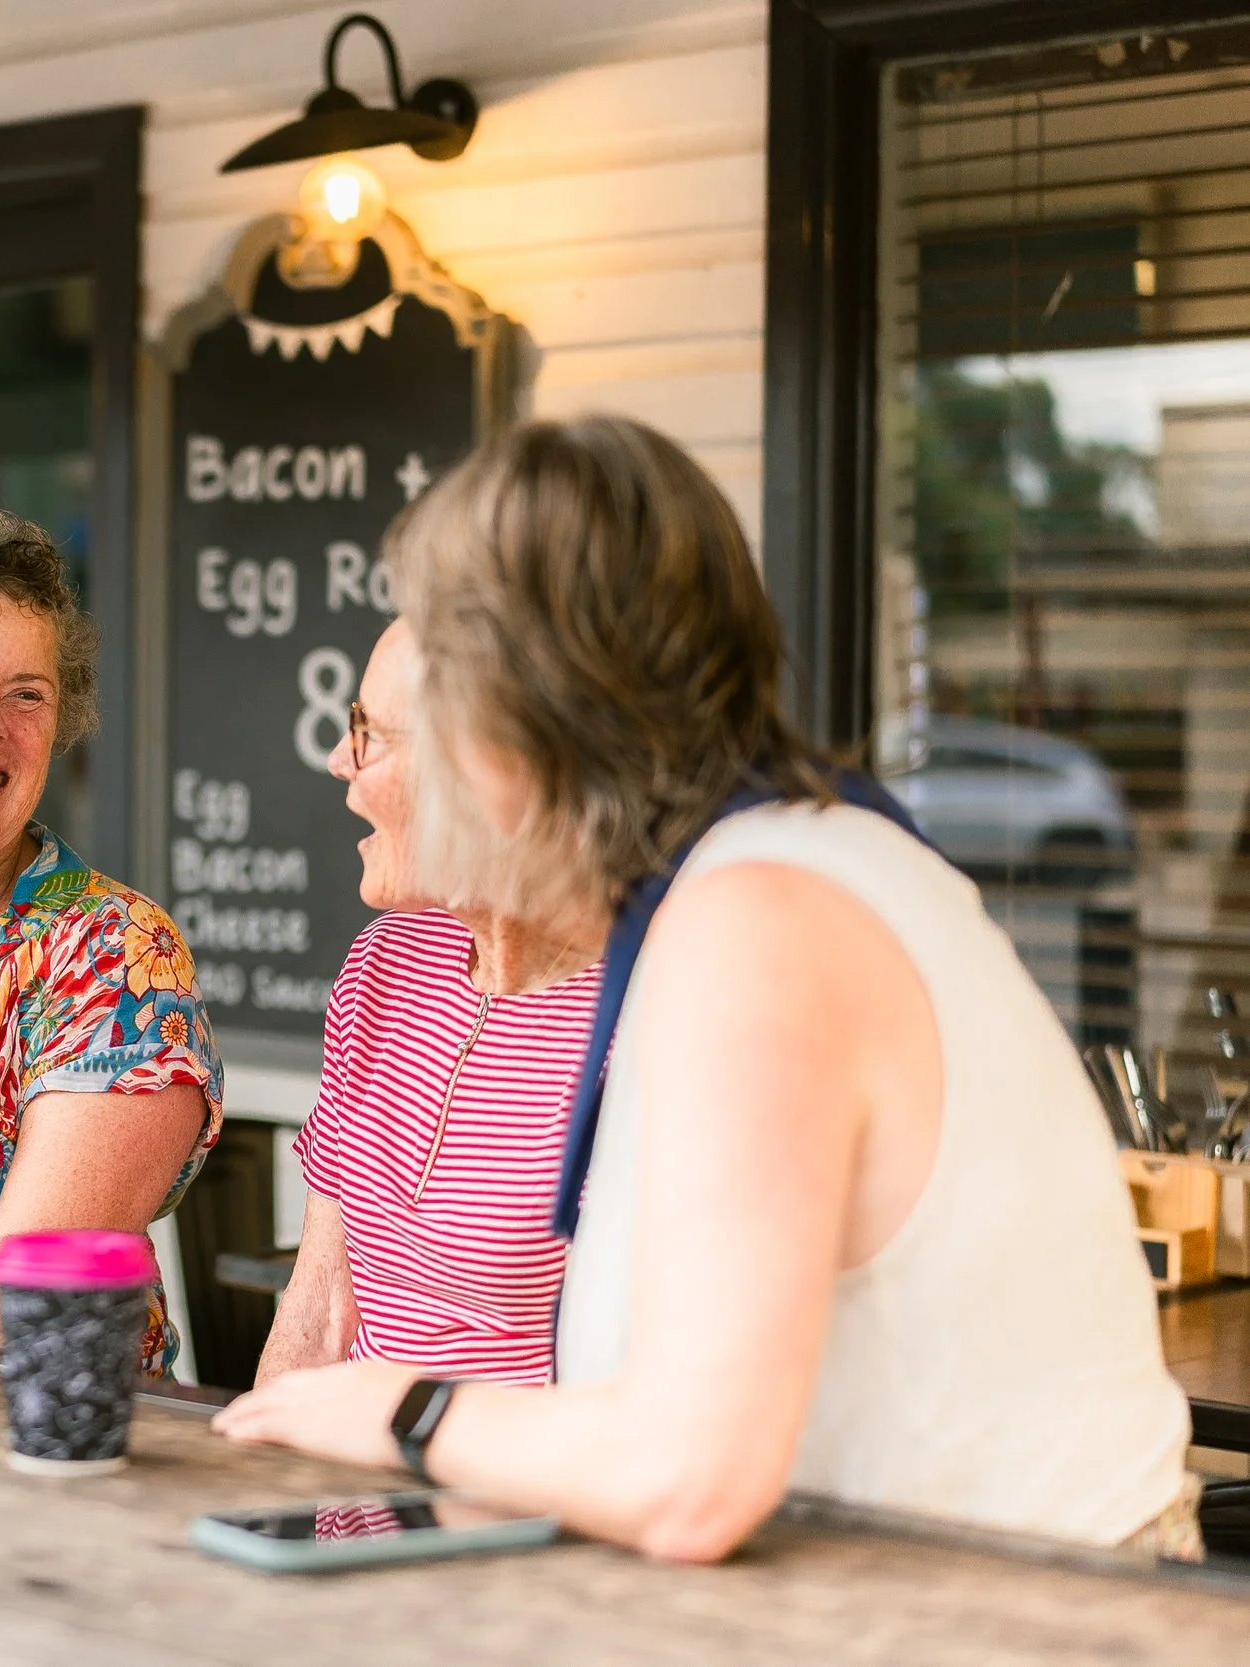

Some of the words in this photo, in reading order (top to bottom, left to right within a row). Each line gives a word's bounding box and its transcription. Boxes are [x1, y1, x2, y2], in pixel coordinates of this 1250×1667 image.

[186, 434, 366, 502] Bacon
[198, 547, 297, 637] Egg
[324, 541, 398, 613] Ro
[174, 769, 249, 841] Egg
[172, 838, 308, 891] Bacon
[173, 896, 311, 953] Cheese
